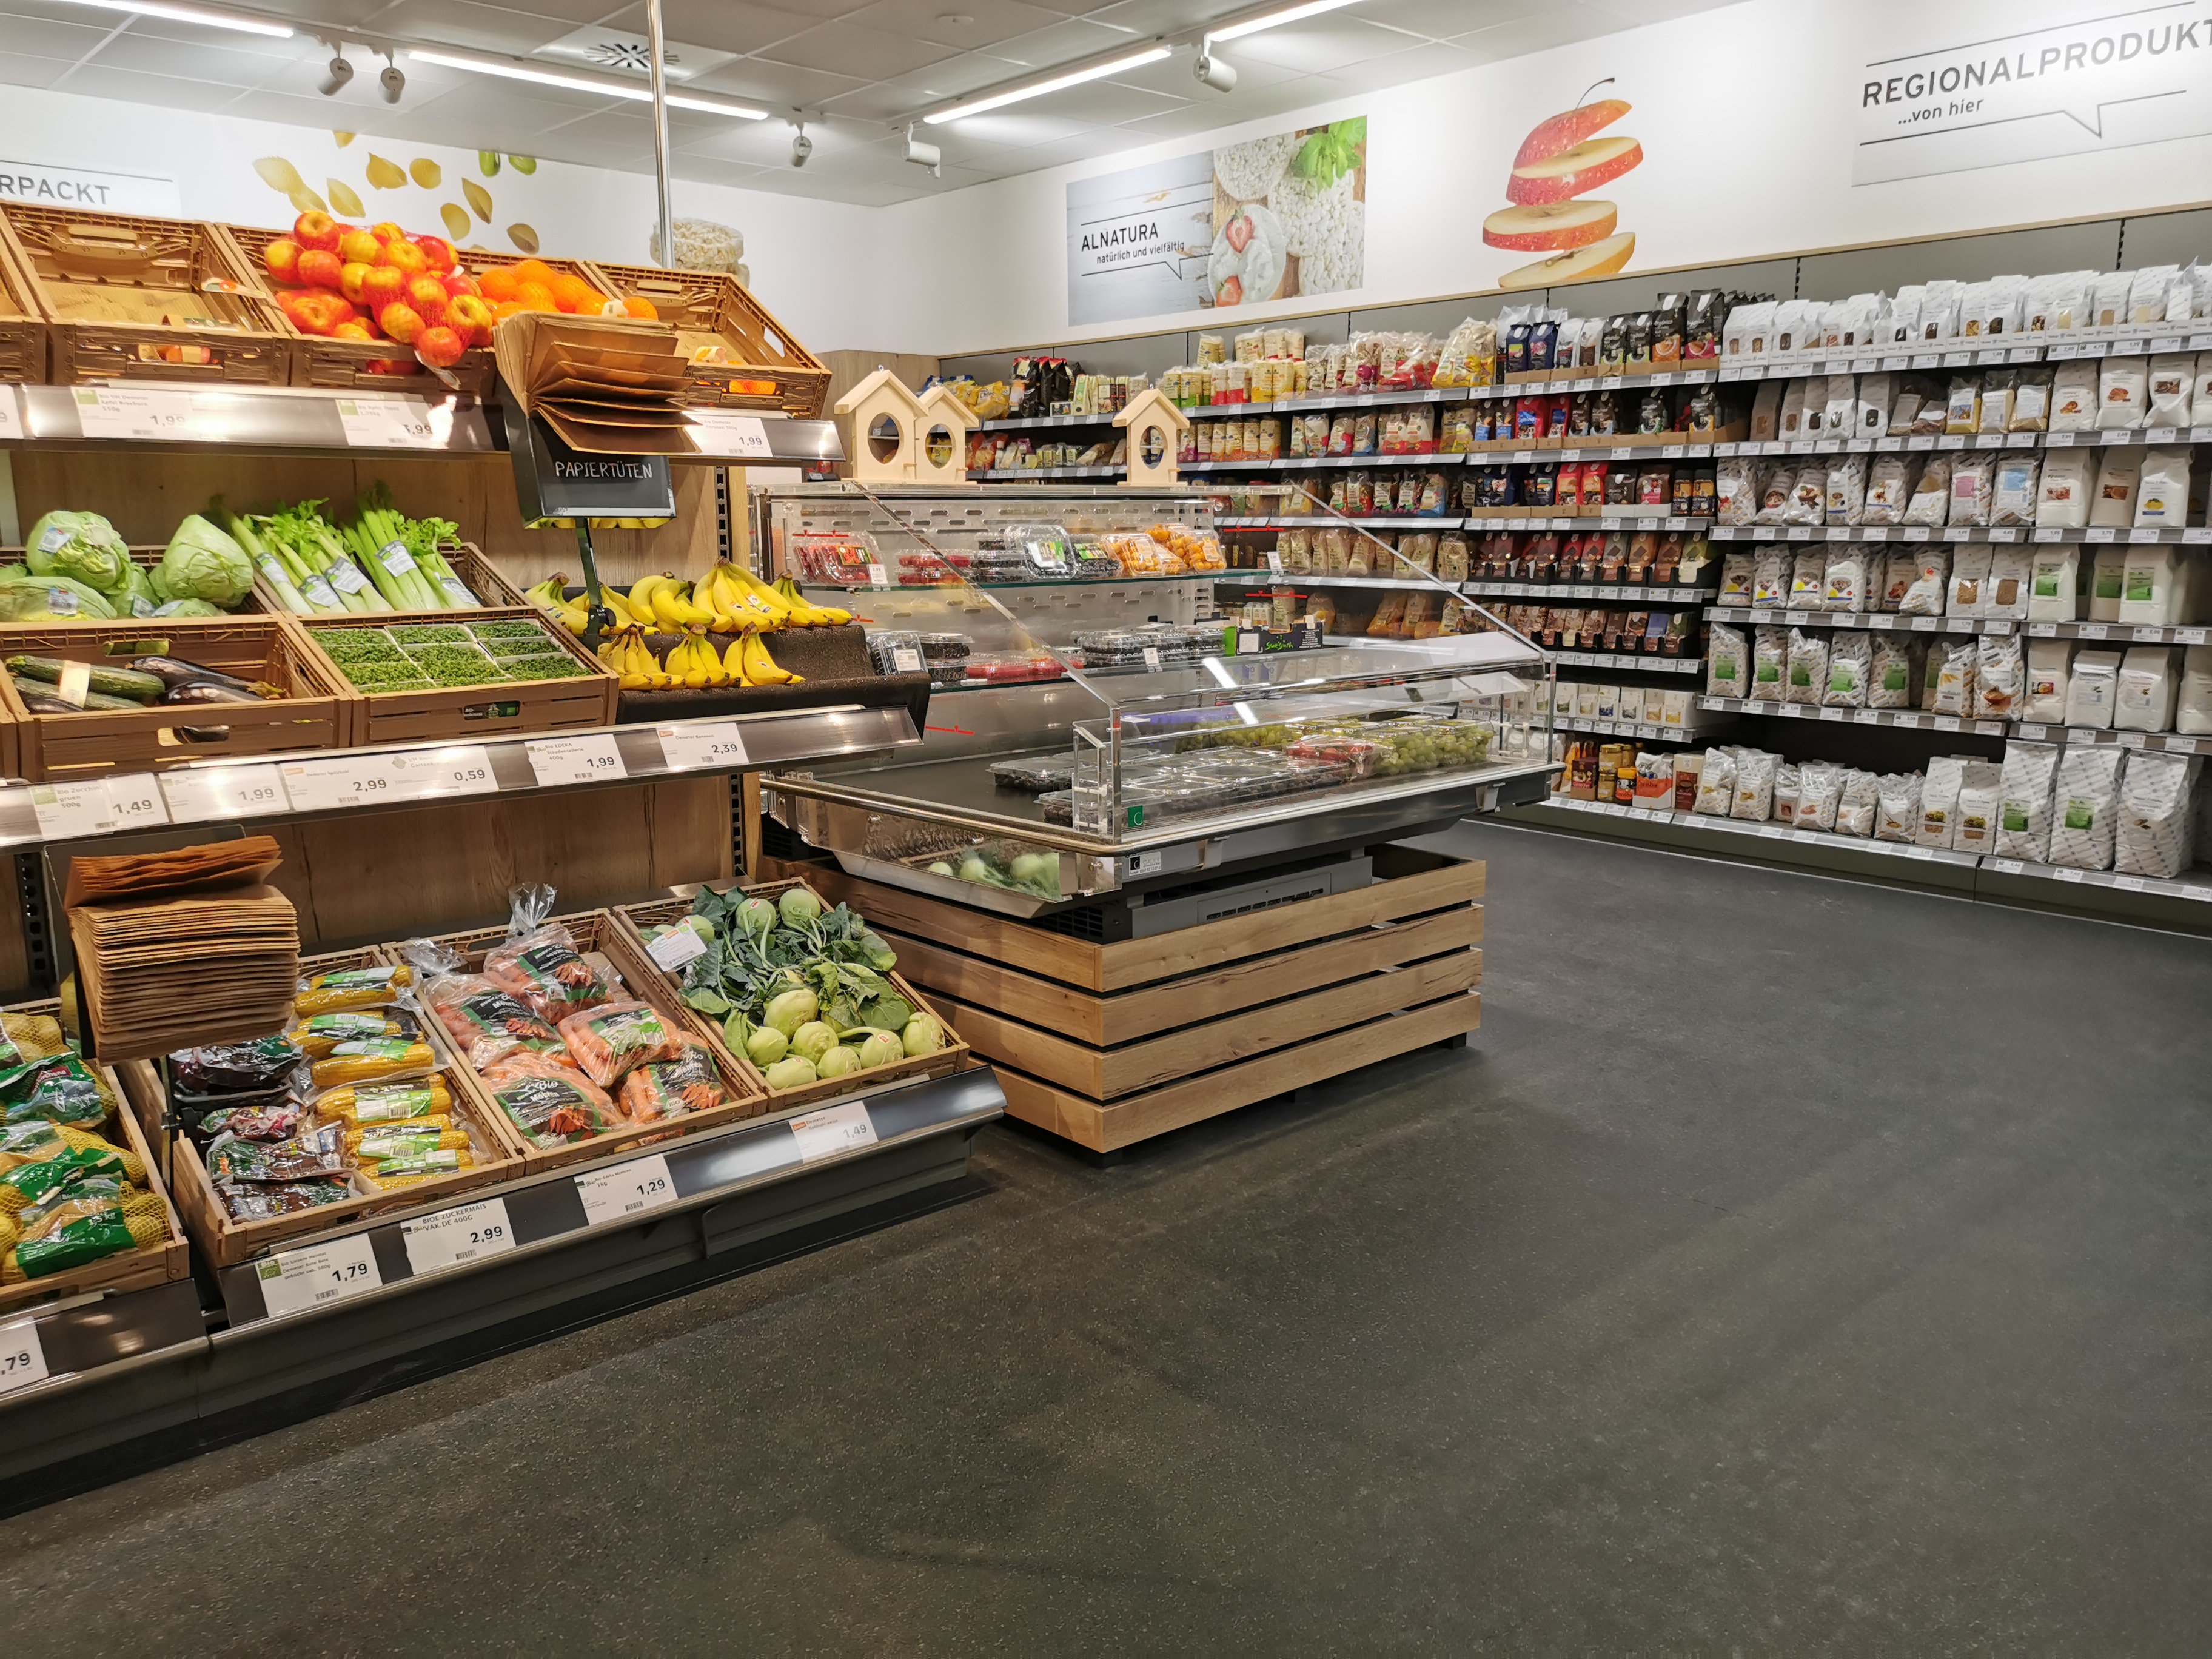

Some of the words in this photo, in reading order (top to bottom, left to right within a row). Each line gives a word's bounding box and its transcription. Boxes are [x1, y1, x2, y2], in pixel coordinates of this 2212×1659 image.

[1948, 98, 1985, 116] hier
[1081, 221, 1159, 252] ALNATURA
[1096, 250, 1131, 264] natürlich
[1132, 246, 1147, 258] und
[1149, 240, 1185, 255] vielfältig
[150, 415, 186, 427] 1,99
[739, 437, 762, 446] 1,99
[555, 460, 652, 478] PAPIERTÜTEN
[711, 743, 737, 754] 2,39
[586, 757, 615, 768] 1,99
[454, 769, 485, 782] 0,59
[353, 779, 387, 792] 2,99
[238, 788, 274, 802] 1,99
[113, 800, 153, 815] 1,49
[535, 1080, 558, 1090] Bio
[806, 1116, 825, 1125] Demeter
[843, 1124, 867, 1139] 1,49
[637, 1179, 665, 1195] 1,29
[422, 1216, 439, 1224] BIOE
[441, 1203, 487, 1219] ZUCKERMAIS
[424, 1220, 452, 1232] VAK.DE
[454, 1214, 473, 1224] 400G
[471, 1226, 503, 1243] 2,99
[332, 1263, 367, 1282] 1,79
